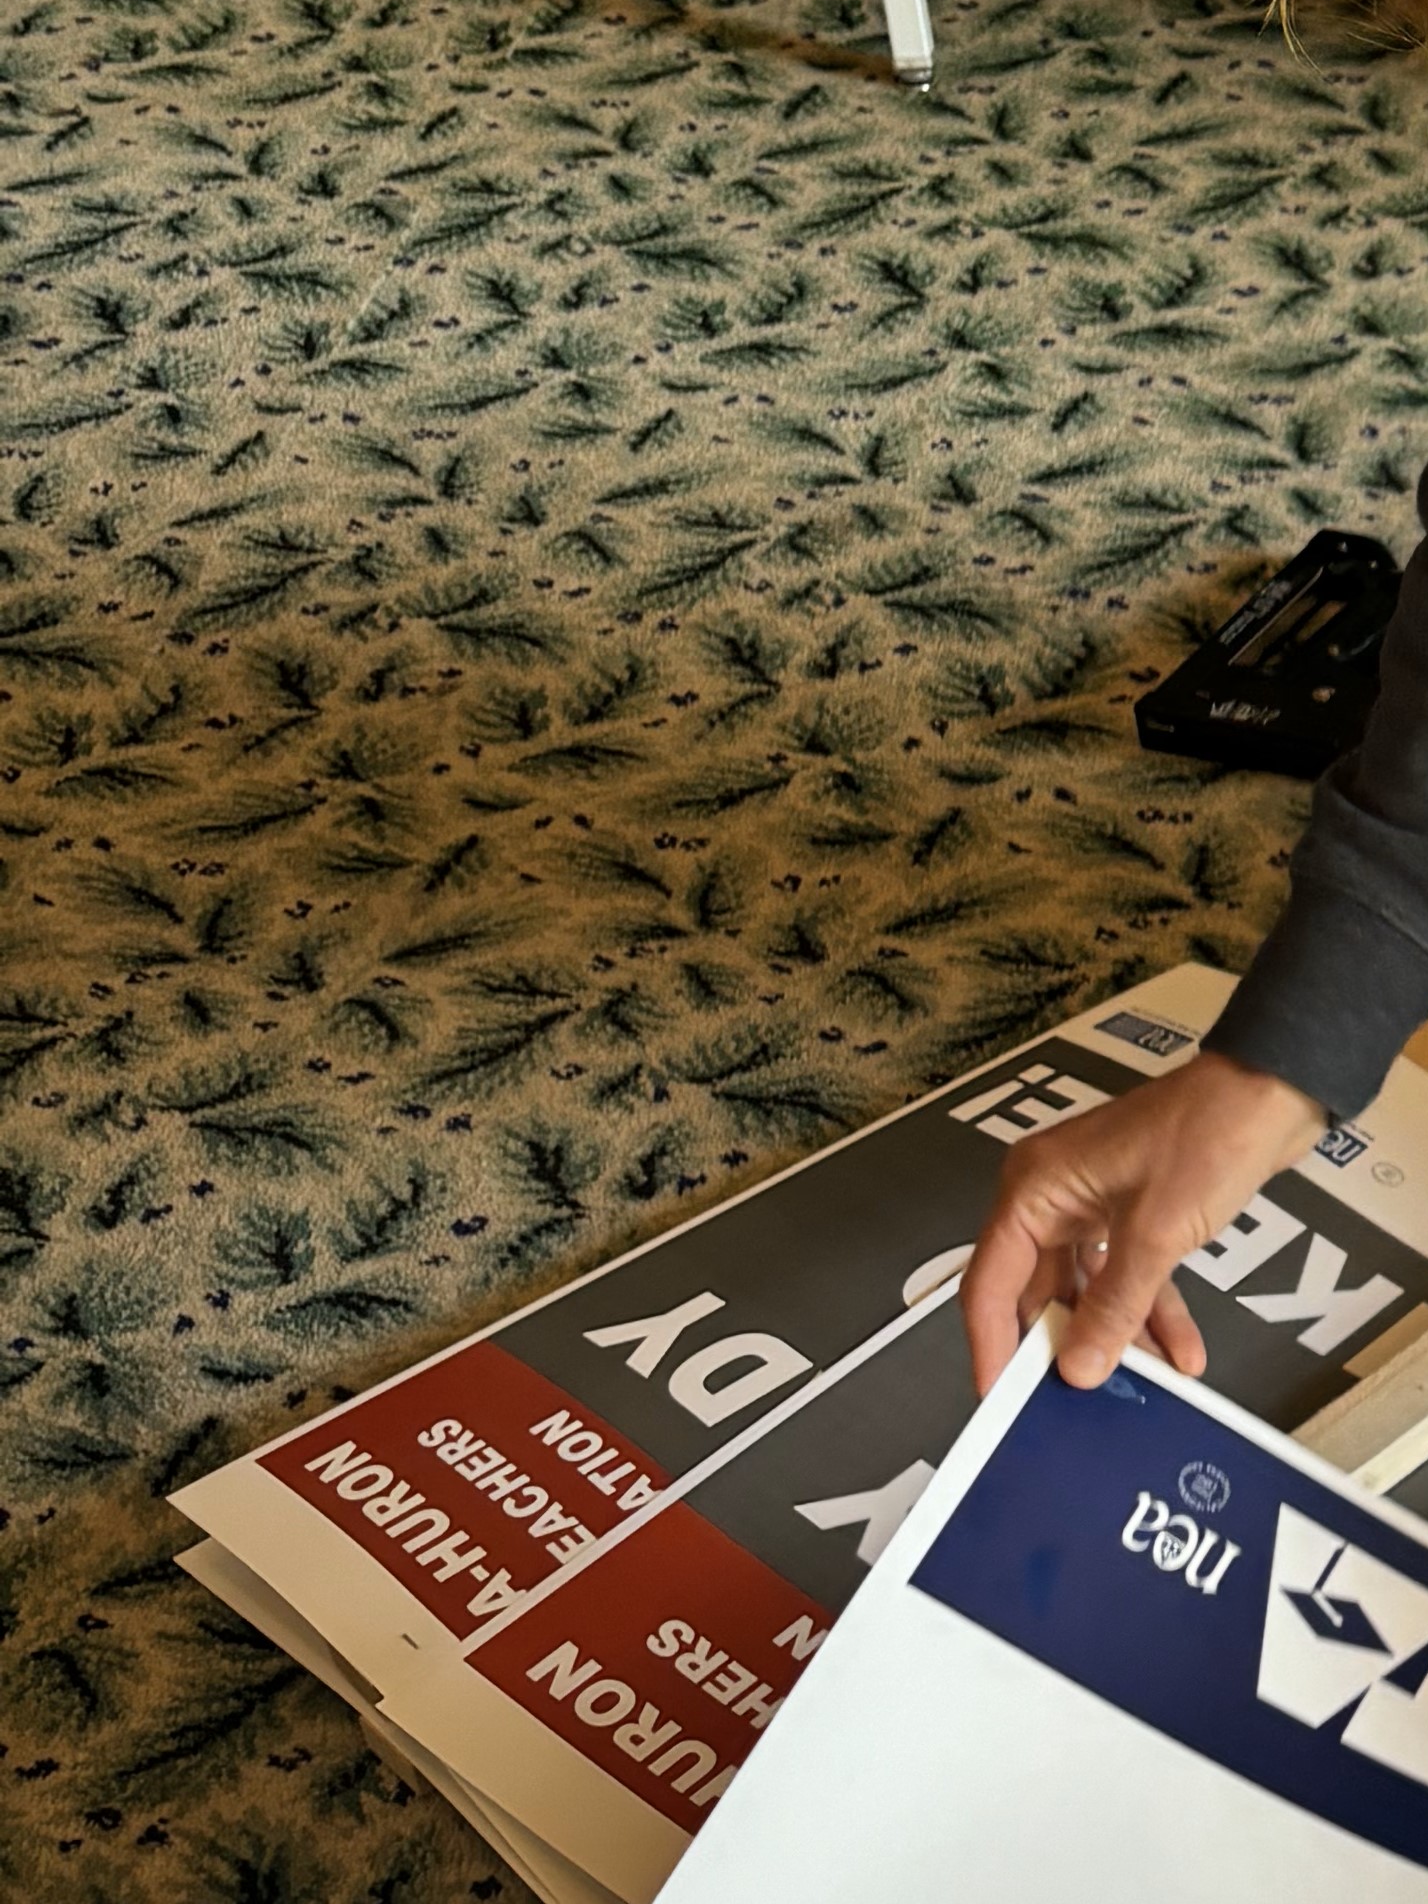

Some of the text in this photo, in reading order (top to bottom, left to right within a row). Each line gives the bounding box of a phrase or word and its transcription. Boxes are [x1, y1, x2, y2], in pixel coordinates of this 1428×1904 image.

[582, 1291, 813, 1428] DY
[303, 1440, 526, 1618] A-HURON
[417, 1418, 596, 1565] EACHERS
[527, 1409, 664, 1513] ATION
[1121, 1491, 1242, 1595] nea
